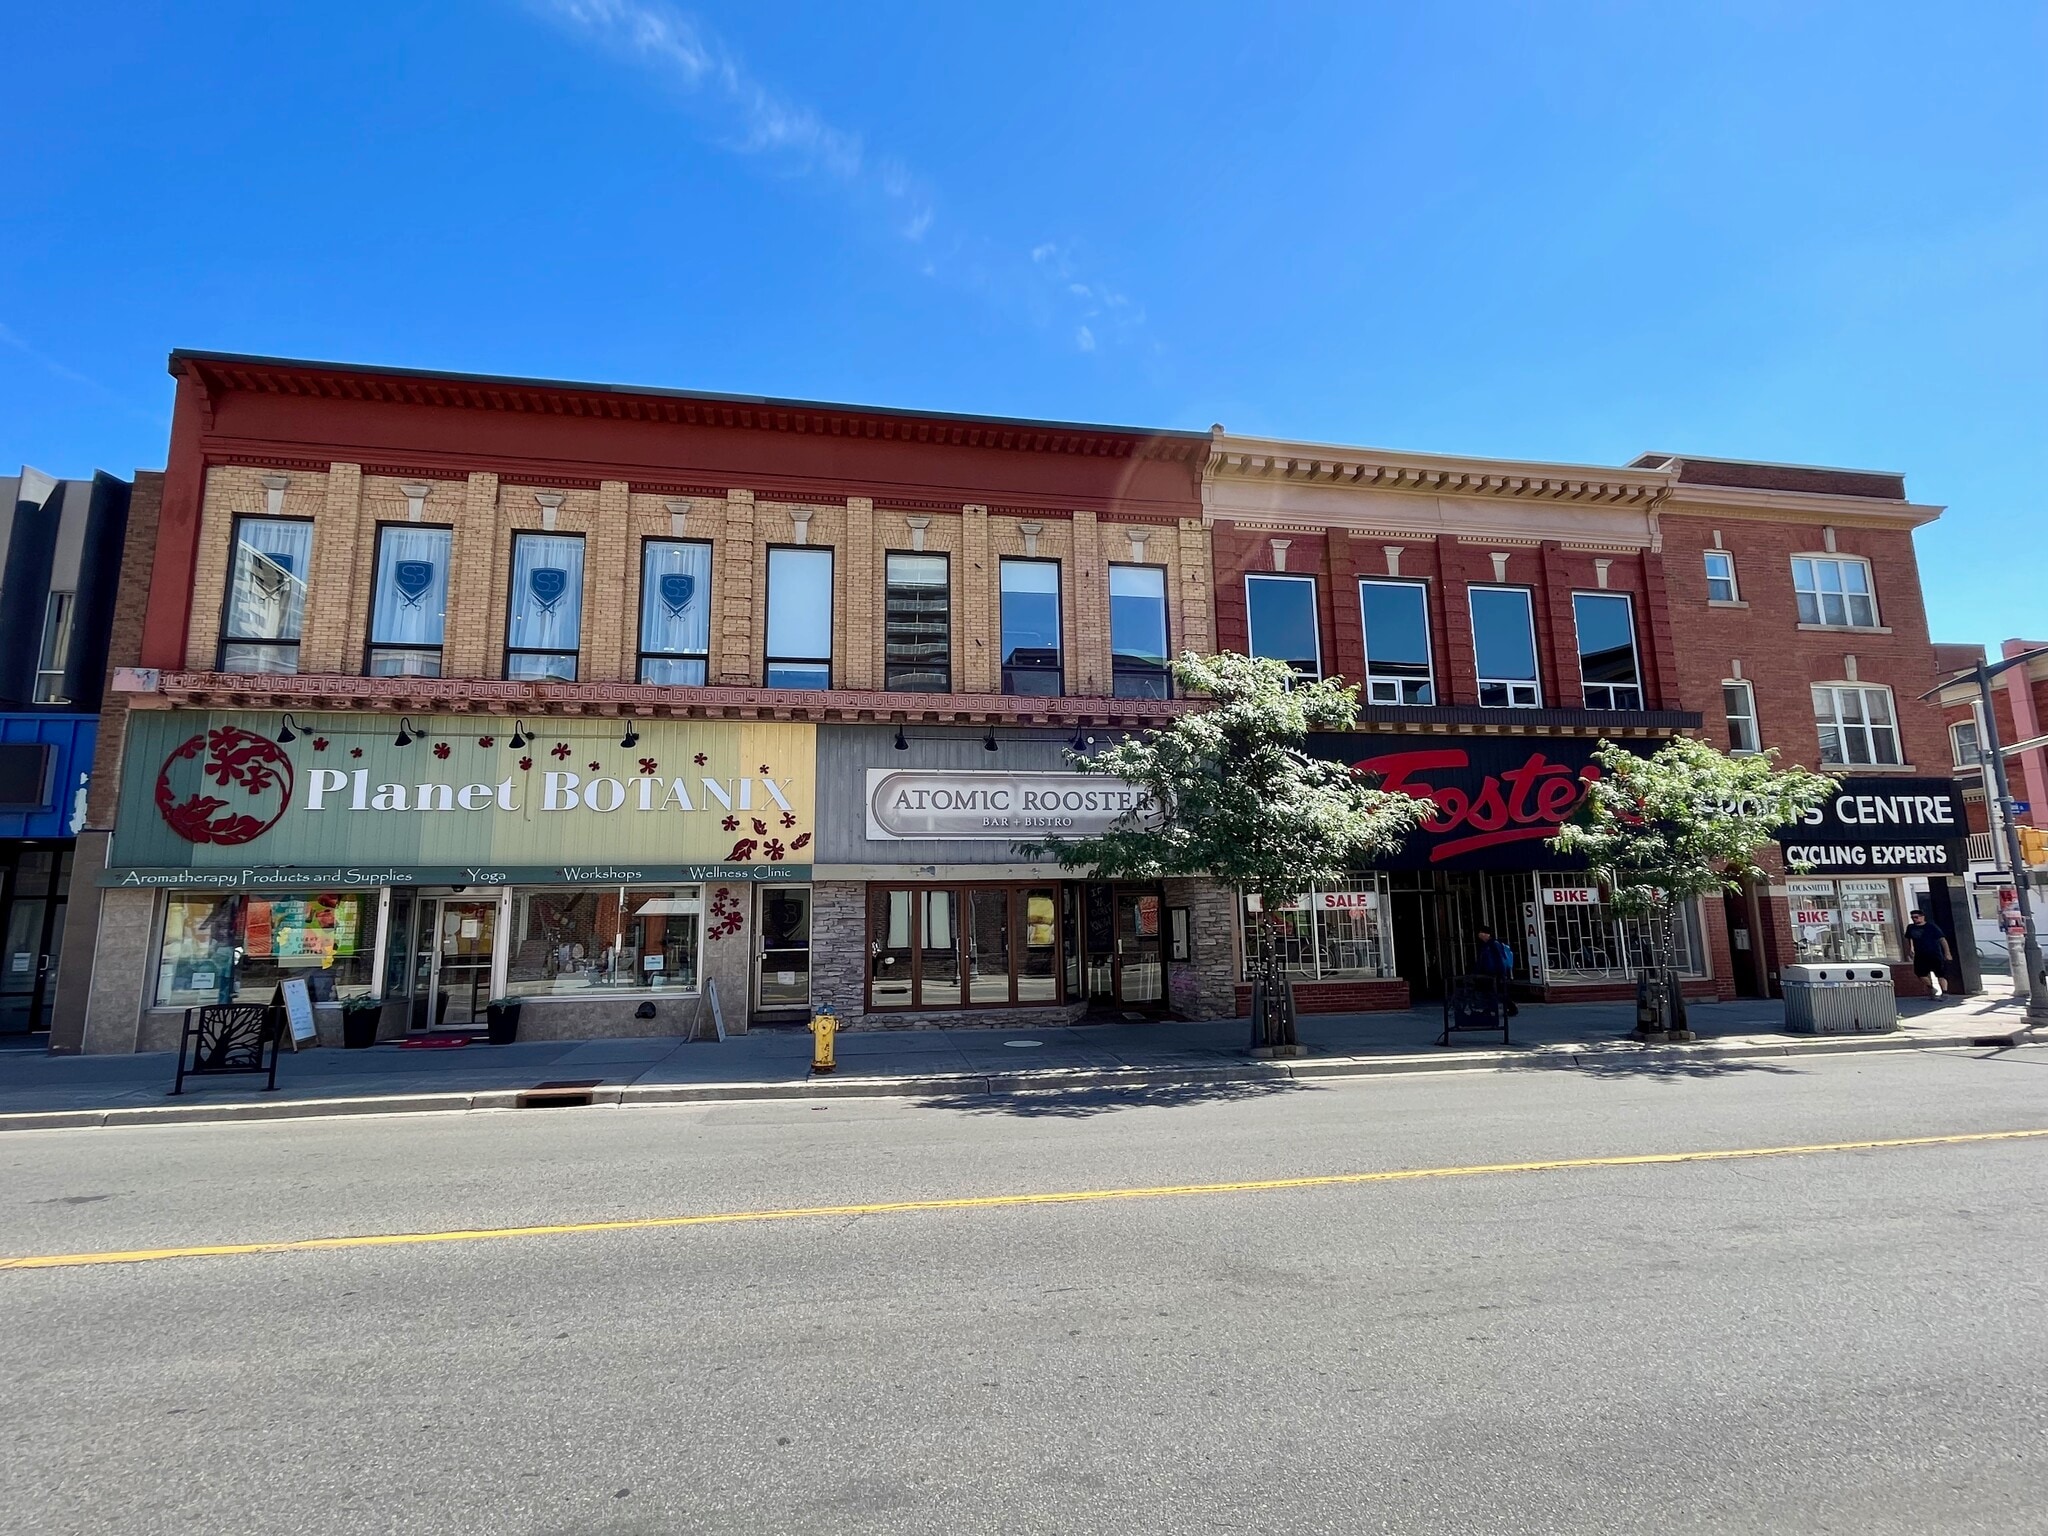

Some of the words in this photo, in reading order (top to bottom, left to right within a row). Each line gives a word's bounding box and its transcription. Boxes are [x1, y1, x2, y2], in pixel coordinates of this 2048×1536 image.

[303, 767, 521, 811] Planet
[540, 771, 793, 812] BOTANIX
[893, 789, 1010, 811] ATOMIC
[1022, 790, 1152, 811] ROOSTER
[1835, 796, 1955, 825] CENTRE
[982, 817, 1009, 827] BAR
[1025, 817, 1073, 827] BISTRO
[1786, 845, 1866, 866] CYCLING
[1872, 845, 1948, 865] EXPERTS
[121, 869, 238, 886] Aromatherapy
[242, 869, 310, 884] Products
[314, 871, 340, 882] and
[344, 869, 413, 884] Supplies
[466, 868, 507, 884] Yoga
[563, 866, 642, 883] Workshops
[690, 866, 748, 879] Wellness
[753, 865, 792, 879] Clinic
[1788, 883, 1830, 892] LOCKSMITH
[1870, 882, 1886, 890] KEYS
[1324, 893, 1368, 907] SALE
[1553, 890, 1589, 902] BIKE
[1797, 911, 1830, 923] BIKE
[1851, 910, 1885, 922] SALE
[1525, 904, 1540, 980] SALE
